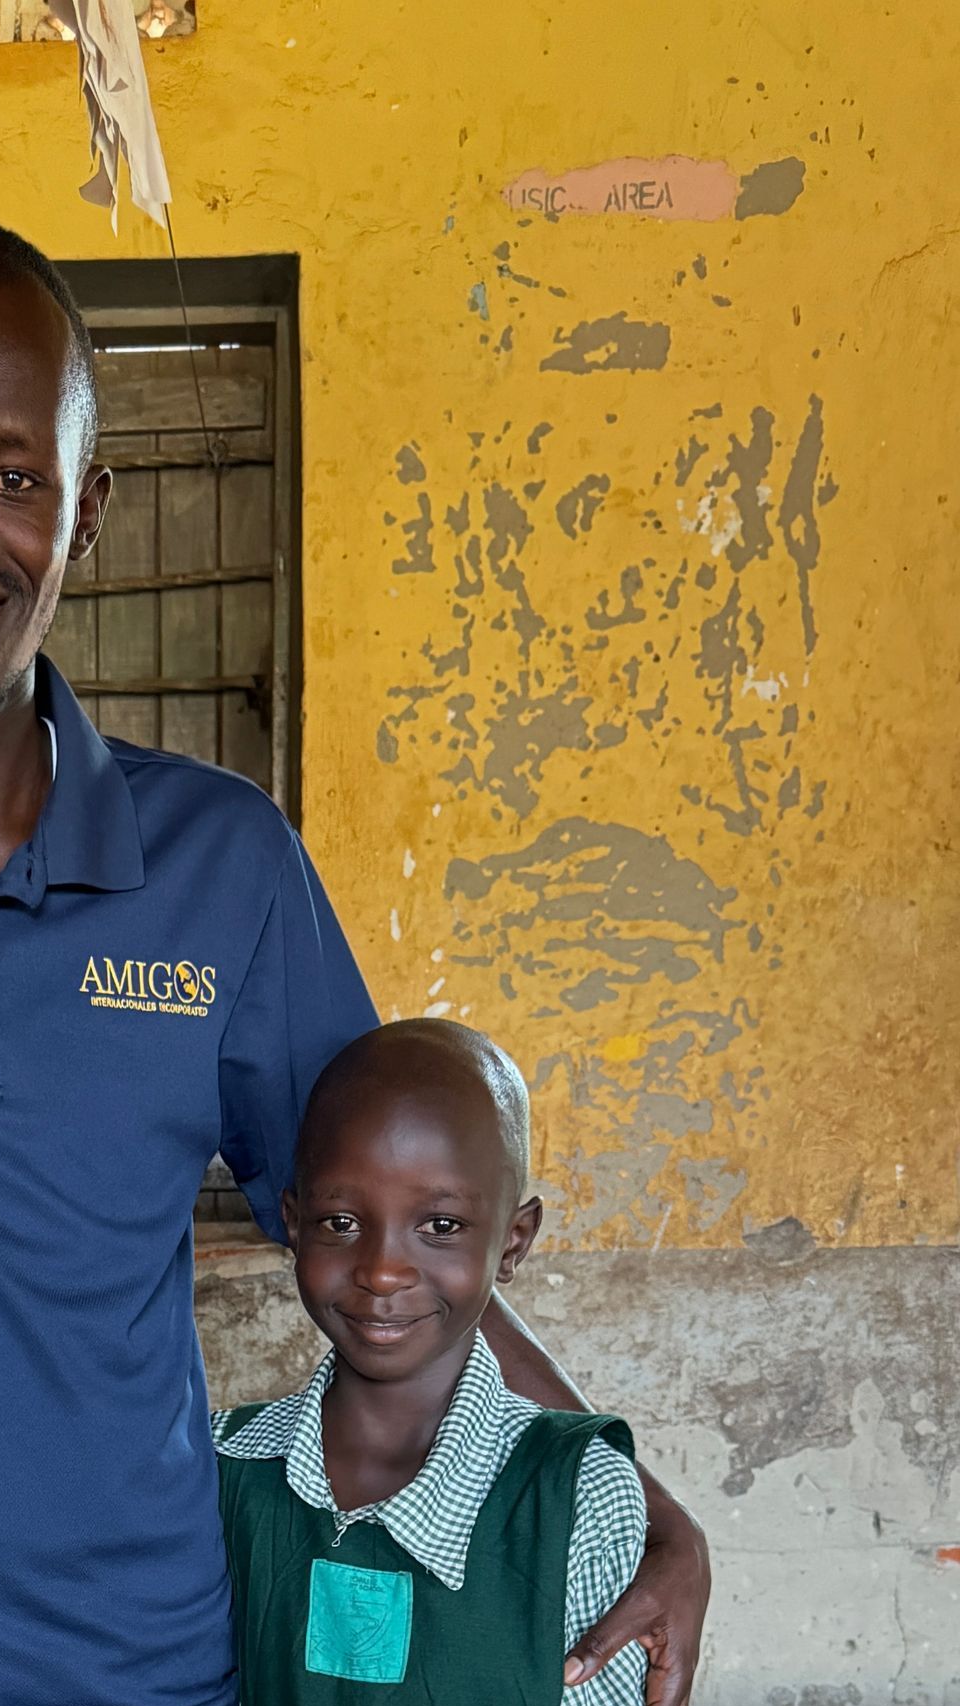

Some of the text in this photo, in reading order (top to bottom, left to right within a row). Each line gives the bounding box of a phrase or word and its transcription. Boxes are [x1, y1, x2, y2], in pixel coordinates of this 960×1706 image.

[604, 181, 674, 212] AREA
[79, 955, 217, 1005] AMIGOS
[90, 995, 209, 1017] INTERNACIONALES INCORPORATED
